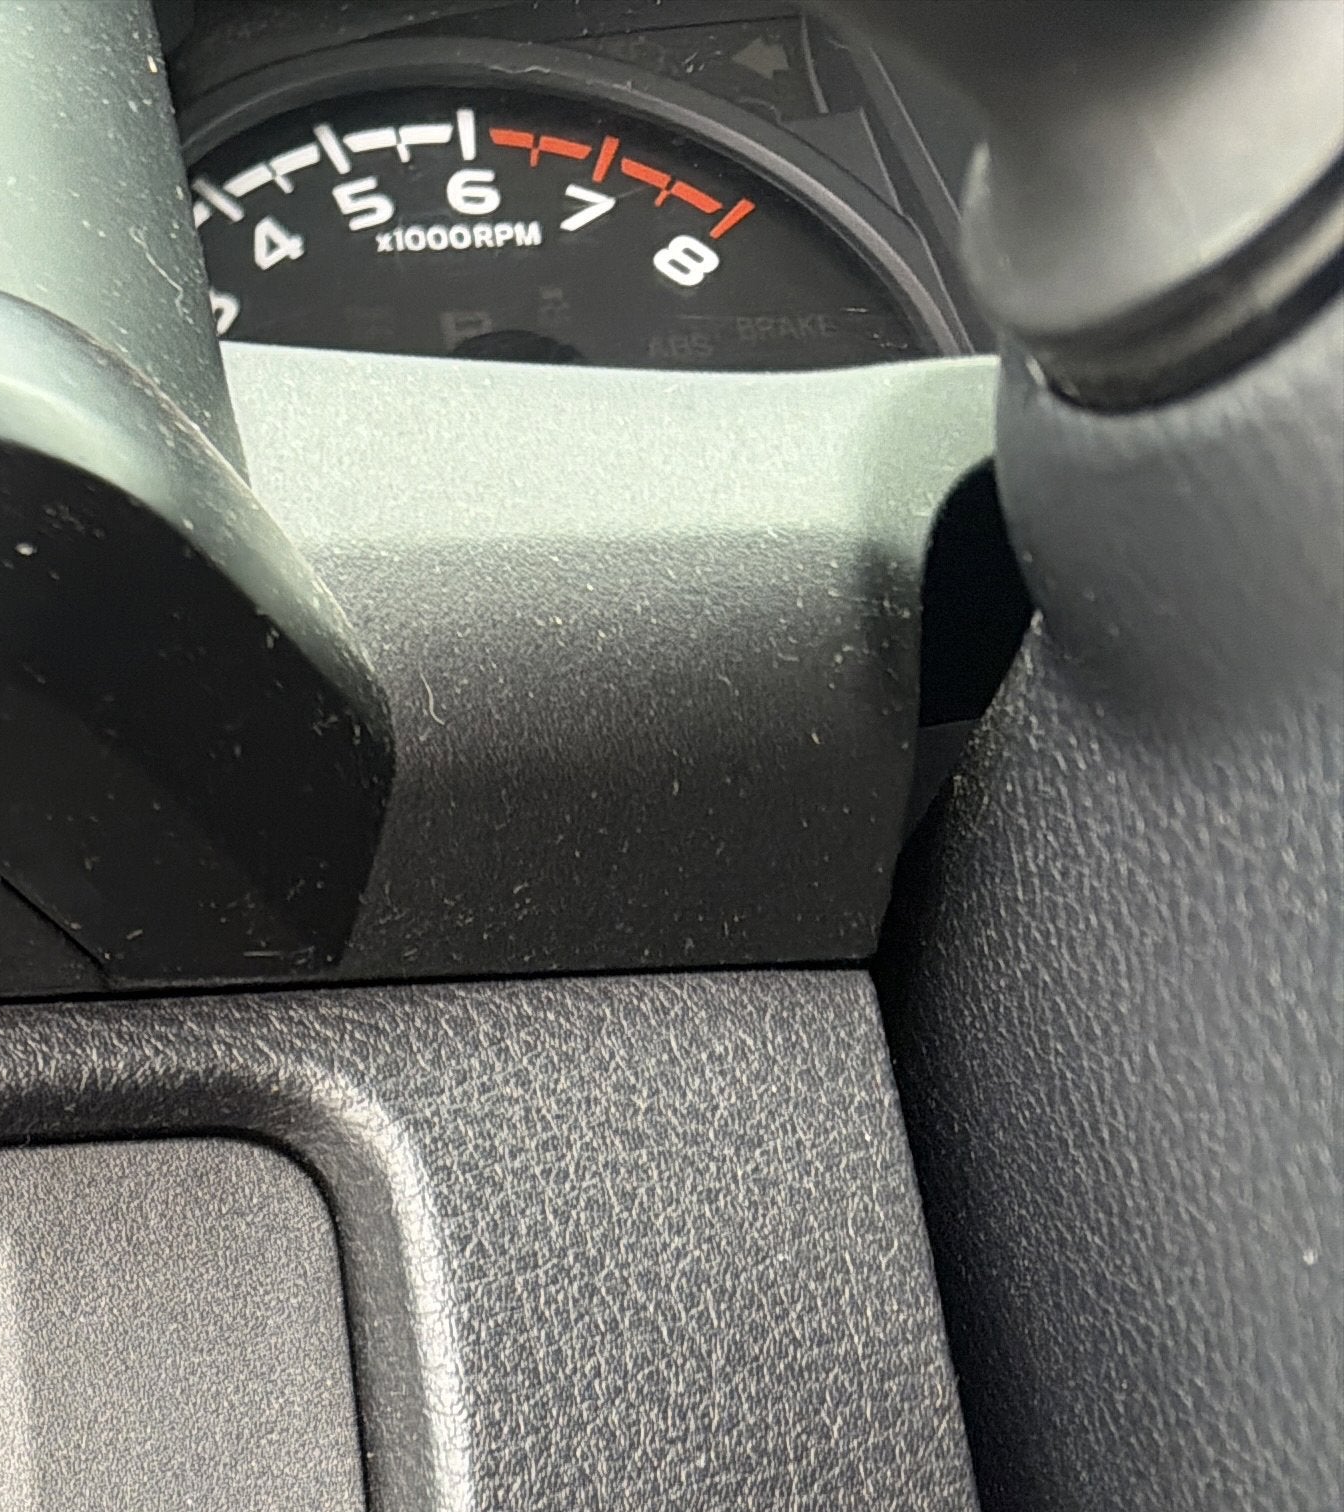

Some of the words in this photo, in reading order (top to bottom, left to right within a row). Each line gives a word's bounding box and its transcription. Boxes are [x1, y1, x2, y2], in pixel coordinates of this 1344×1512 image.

[254, 215, 305, 271] 4
[332, 176, 395, 232] 5
[446, 168, 502, 216] 6
[560, 183, 616, 232] 7
[653, 234, 720, 287] 8
